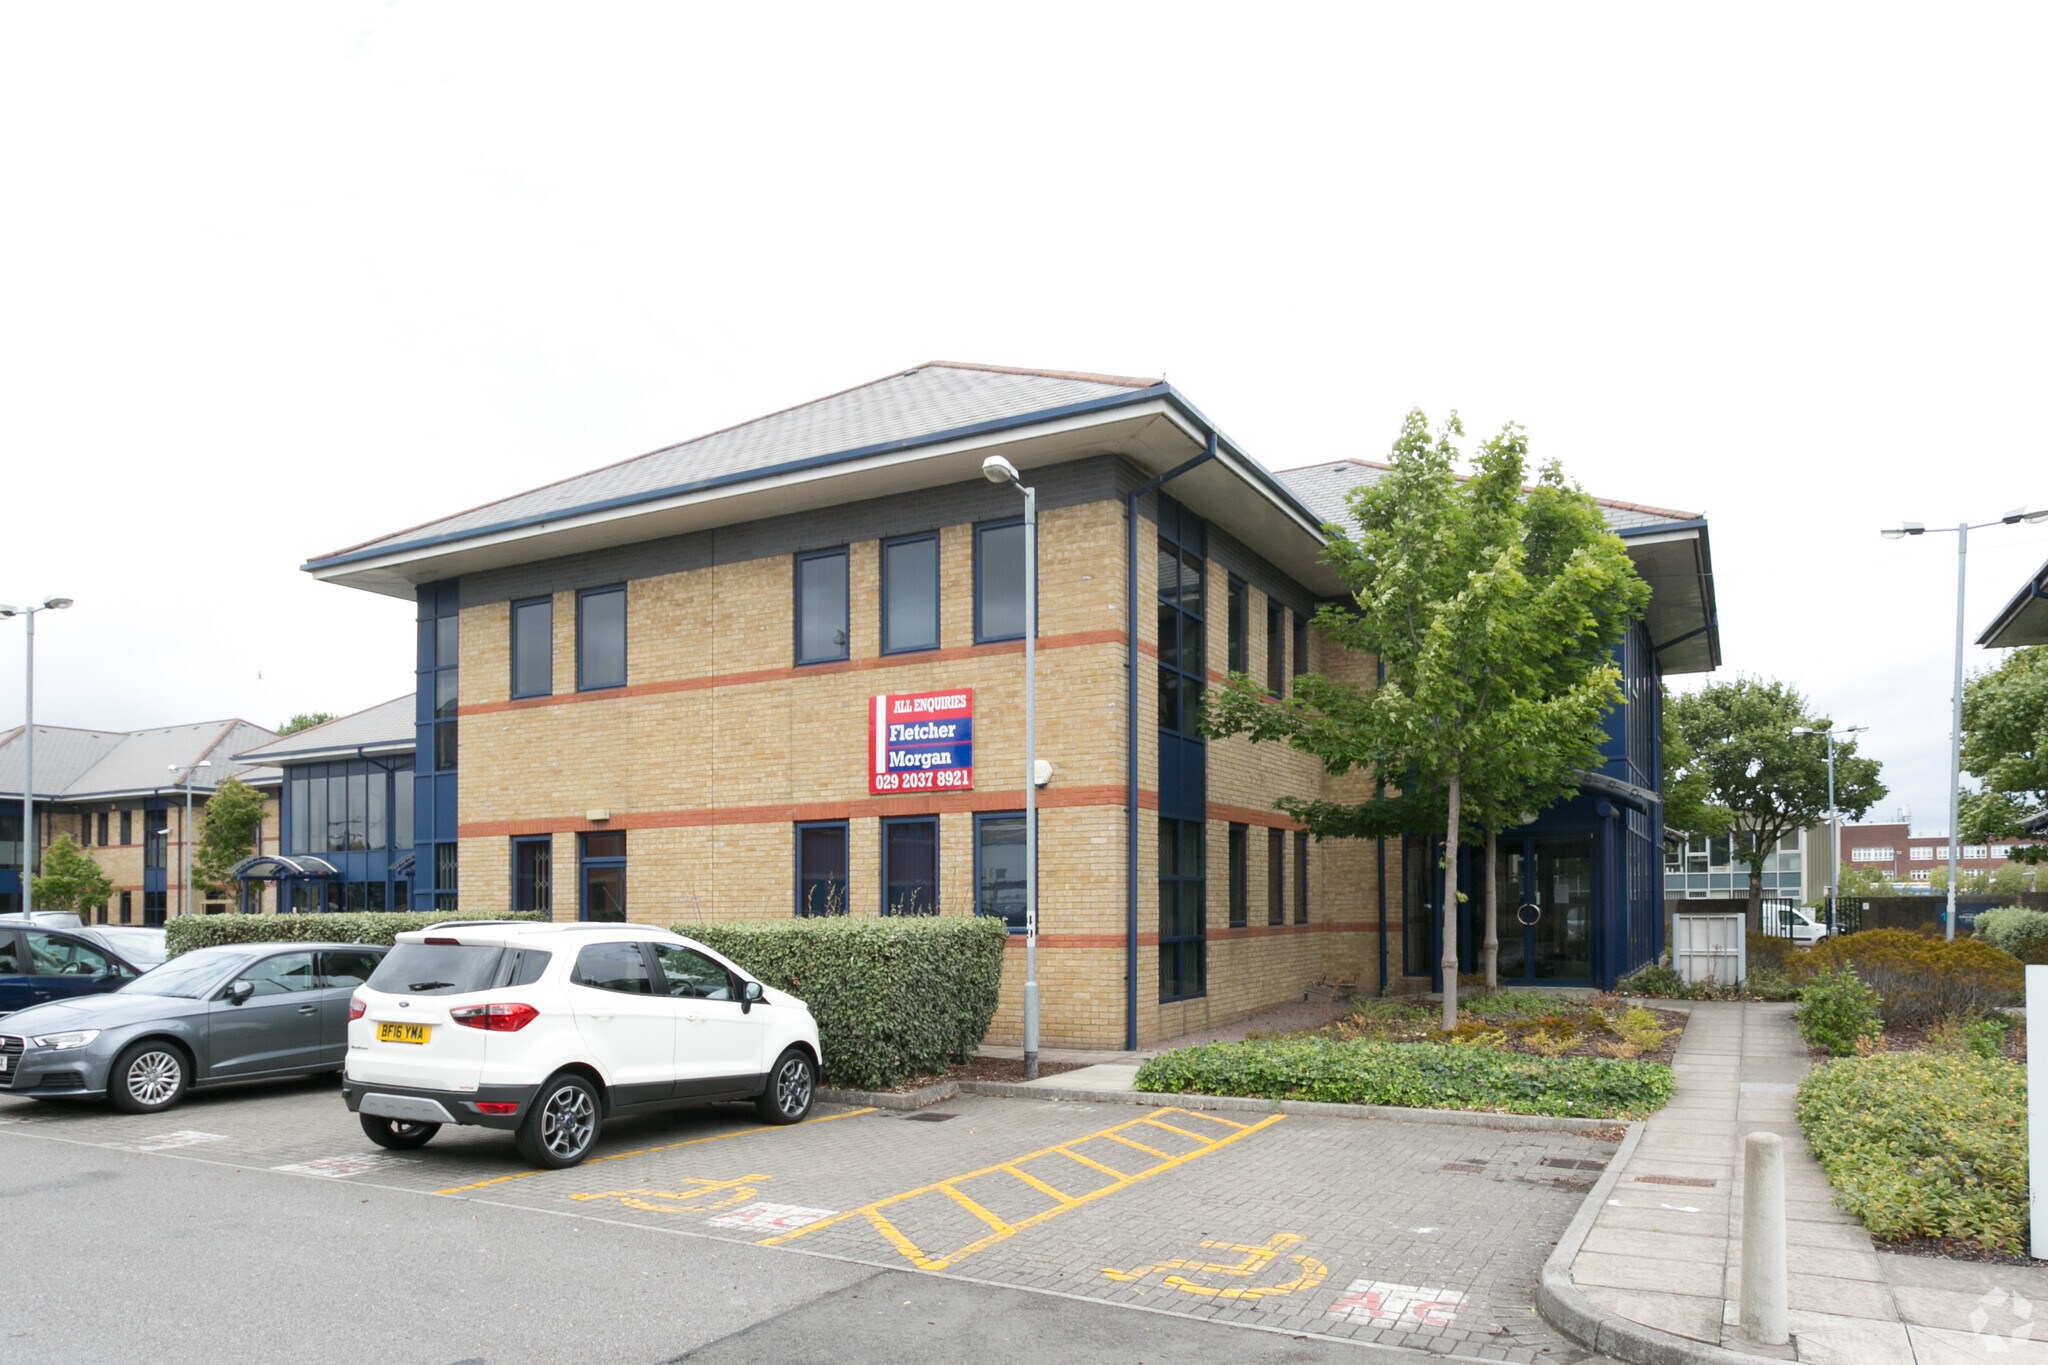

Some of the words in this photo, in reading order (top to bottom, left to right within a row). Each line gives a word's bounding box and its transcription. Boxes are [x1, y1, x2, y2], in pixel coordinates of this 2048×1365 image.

[893, 699, 912, 714] ALL
[914, 694, 967, 713] ENQUIRIES
[889, 722, 956, 741] Fletcher
[889, 751, 952, 769] Morgan
[875, 774, 899, 790] 029
[902, 772, 933, 789] 2037
[937, 770, 969, 787] 8921
[381, 1024, 403, 1039] BF16
[405, 1025, 423, 1040] YMA
